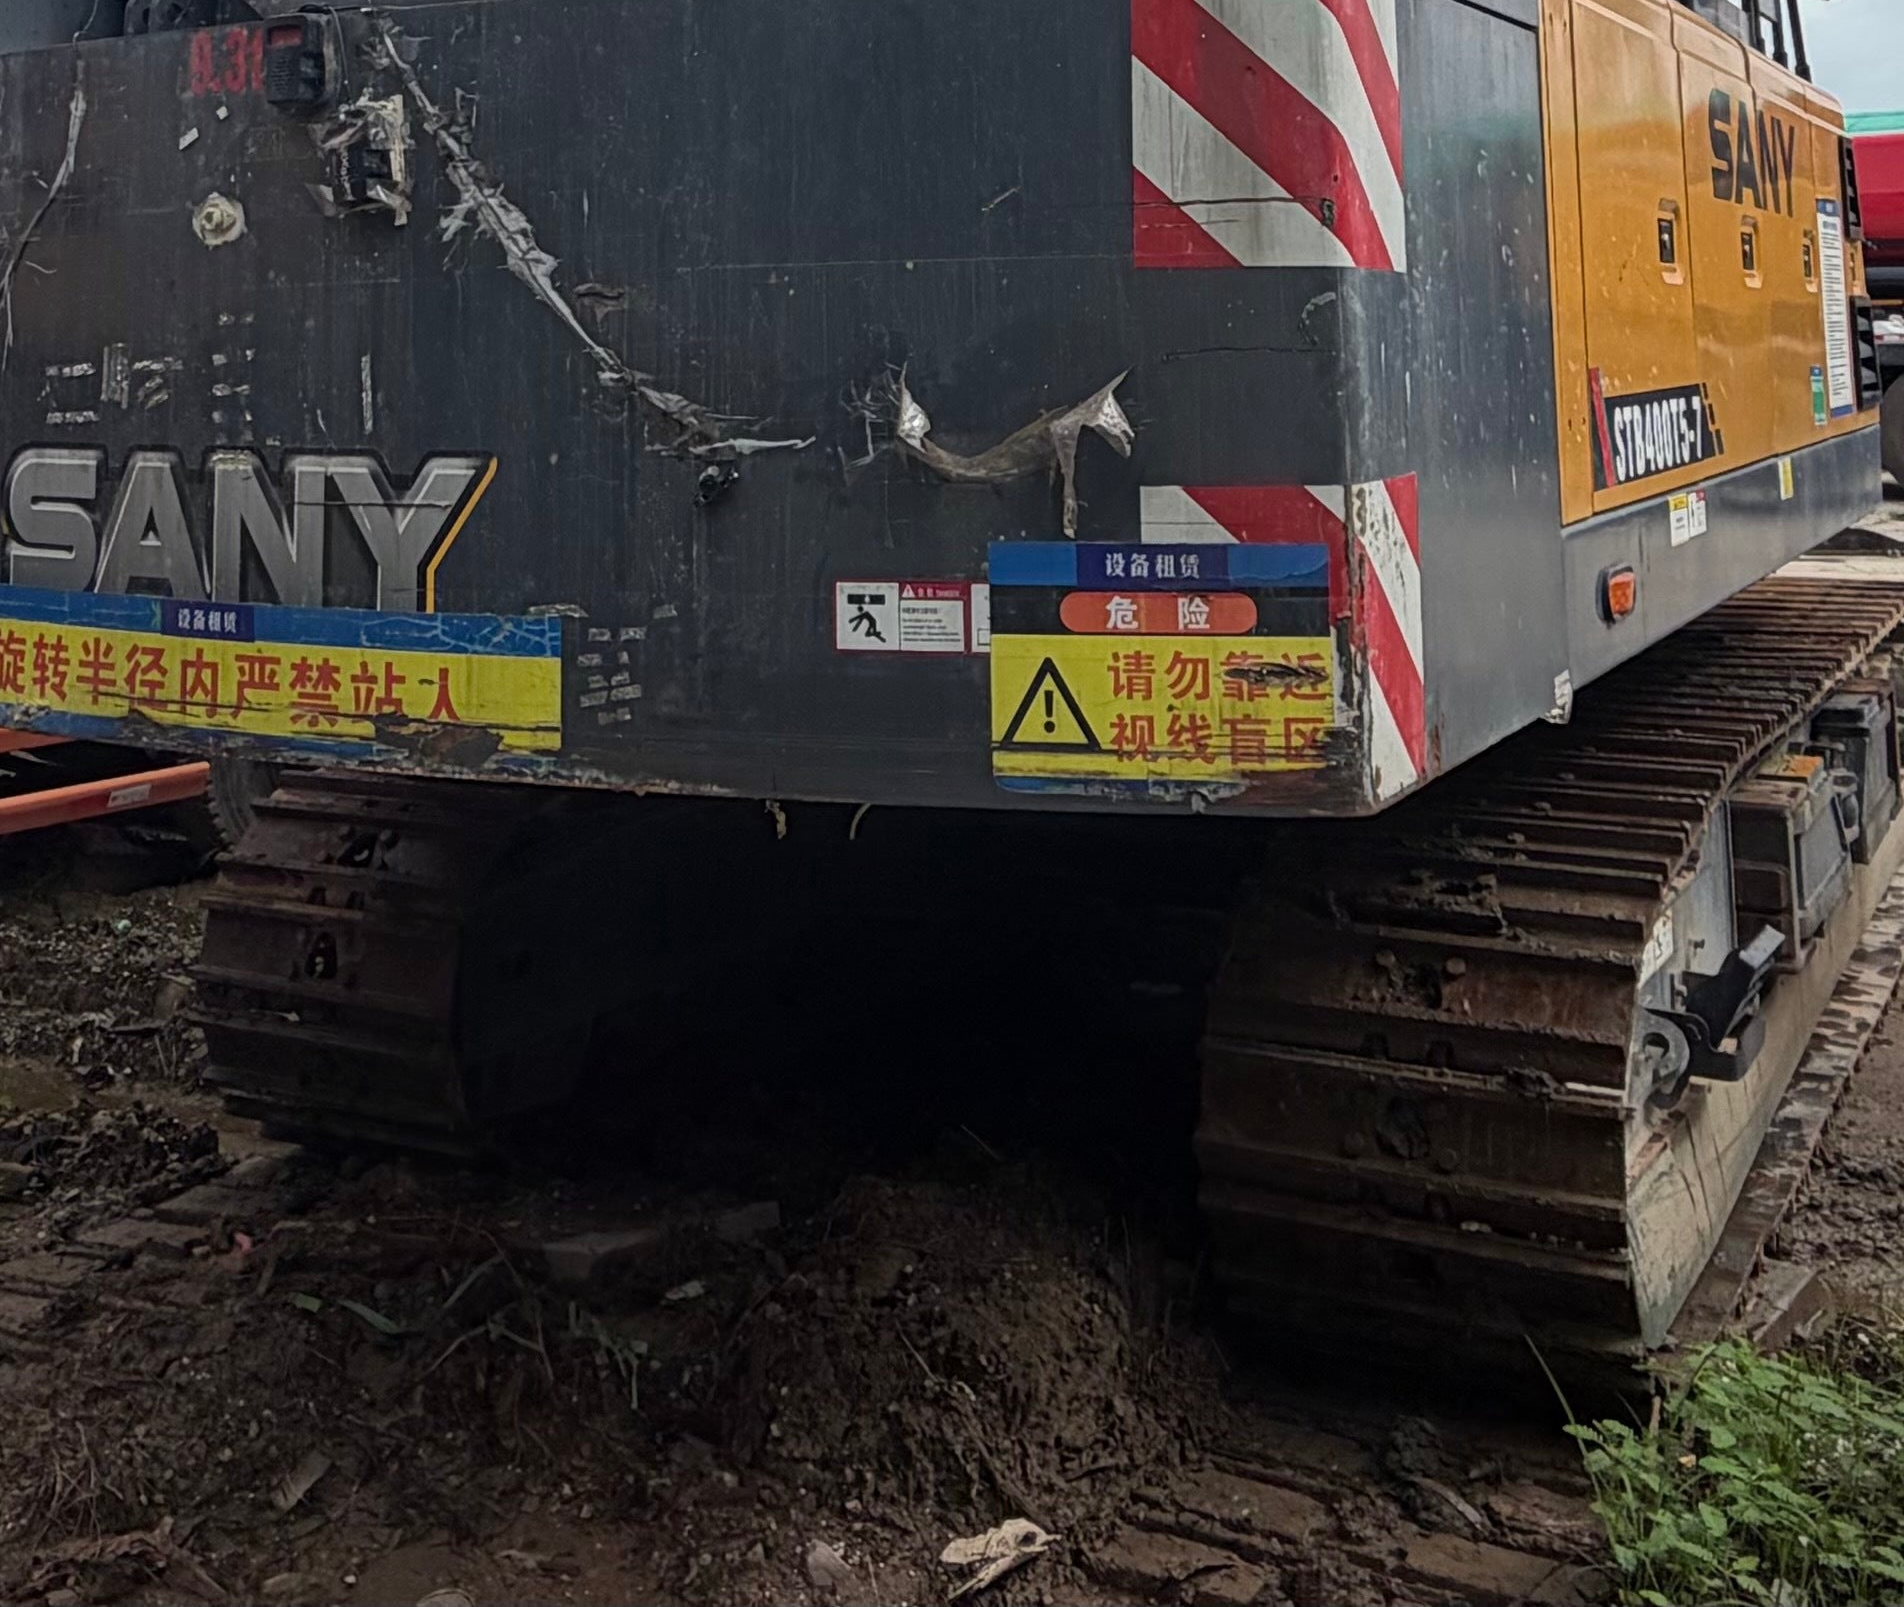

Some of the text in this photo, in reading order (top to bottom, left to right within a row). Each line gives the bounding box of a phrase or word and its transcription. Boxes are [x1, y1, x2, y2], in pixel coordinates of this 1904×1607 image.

[1708, 88, 1795, 218] SANY
[2, 442, 498, 613] SANY
[1105, 552, 1201, 580] 设备租赁
[1107, 649, 1329, 702] 请勿靠近
[1109, 713, 1329, 767] 视线盲区
